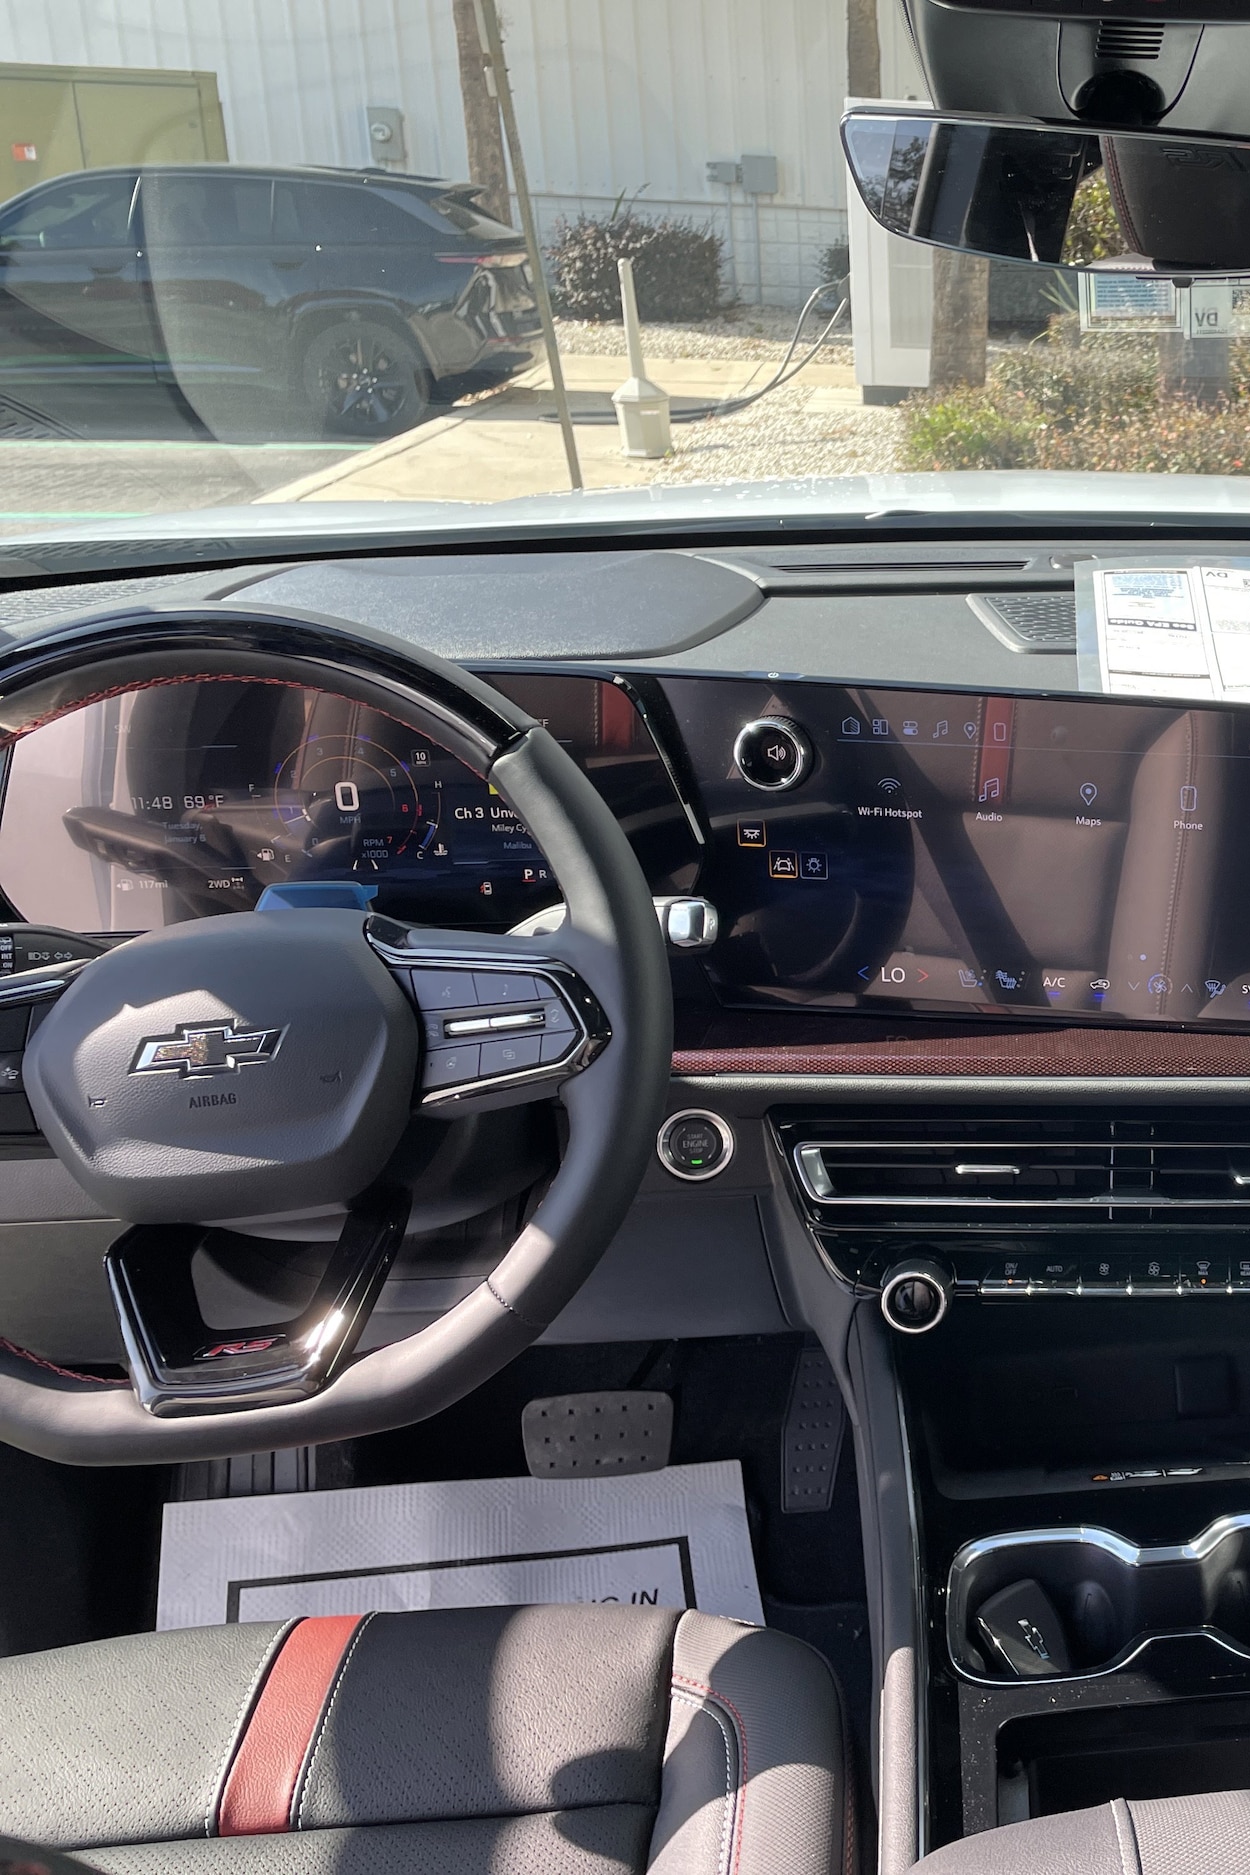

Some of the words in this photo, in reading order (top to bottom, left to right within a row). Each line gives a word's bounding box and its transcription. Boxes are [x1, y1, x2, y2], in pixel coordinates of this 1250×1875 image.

[1146, 620, 1170, 628] EPA
[1172, 622, 1195, 630] See
[415, 752, 426, 761] 10
[390, 769, 396, 777] 5
[249, 784, 255, 792] F
[434, 781, 442, 789] H
[334, 781, 360, 811] 0
[131, 796, 173, 810] 11:48
[455, 807, 472, 819] Ch
[475, 807, 484, 819] 3
[858, 806, 883, 817] Wi-Fi
[884, 807, 923, 819] Hotspot
[975, 811, 1003, 822] Audio
[339, 816, 362, 824] MPH
[1075, 816, 1102, 828] Maps
[491, 824, 514, 834] Miley
[1173, 820, 1204, 831] Phone
[165, 835, 197, 843] January
[363, 839, 384, 847] RPM
[387, 836, 393, 844] 7
[503, 841, 532, 849] Malibu
[285, 855, 291, 863] E
[416, 851, 423, 859] C
[524, 869, 533, 879] P
[539, 870, 547, 878] R
[208, 880, 230, 889] 2WD
[880, 967, 906, 983] LO
[1043, 977, 1066, 989] A/C
[189, 1092, 237, 1109] AIRBAG
[682, 1140, 709, 1148] ENGINE
[1005, 1262, 1018, 1270] ON/
[1046, 1265, 1063, 1273] AUTO
[203, 1338, 279, 1358] RS
[631, 1587, 659, 1605] IN
